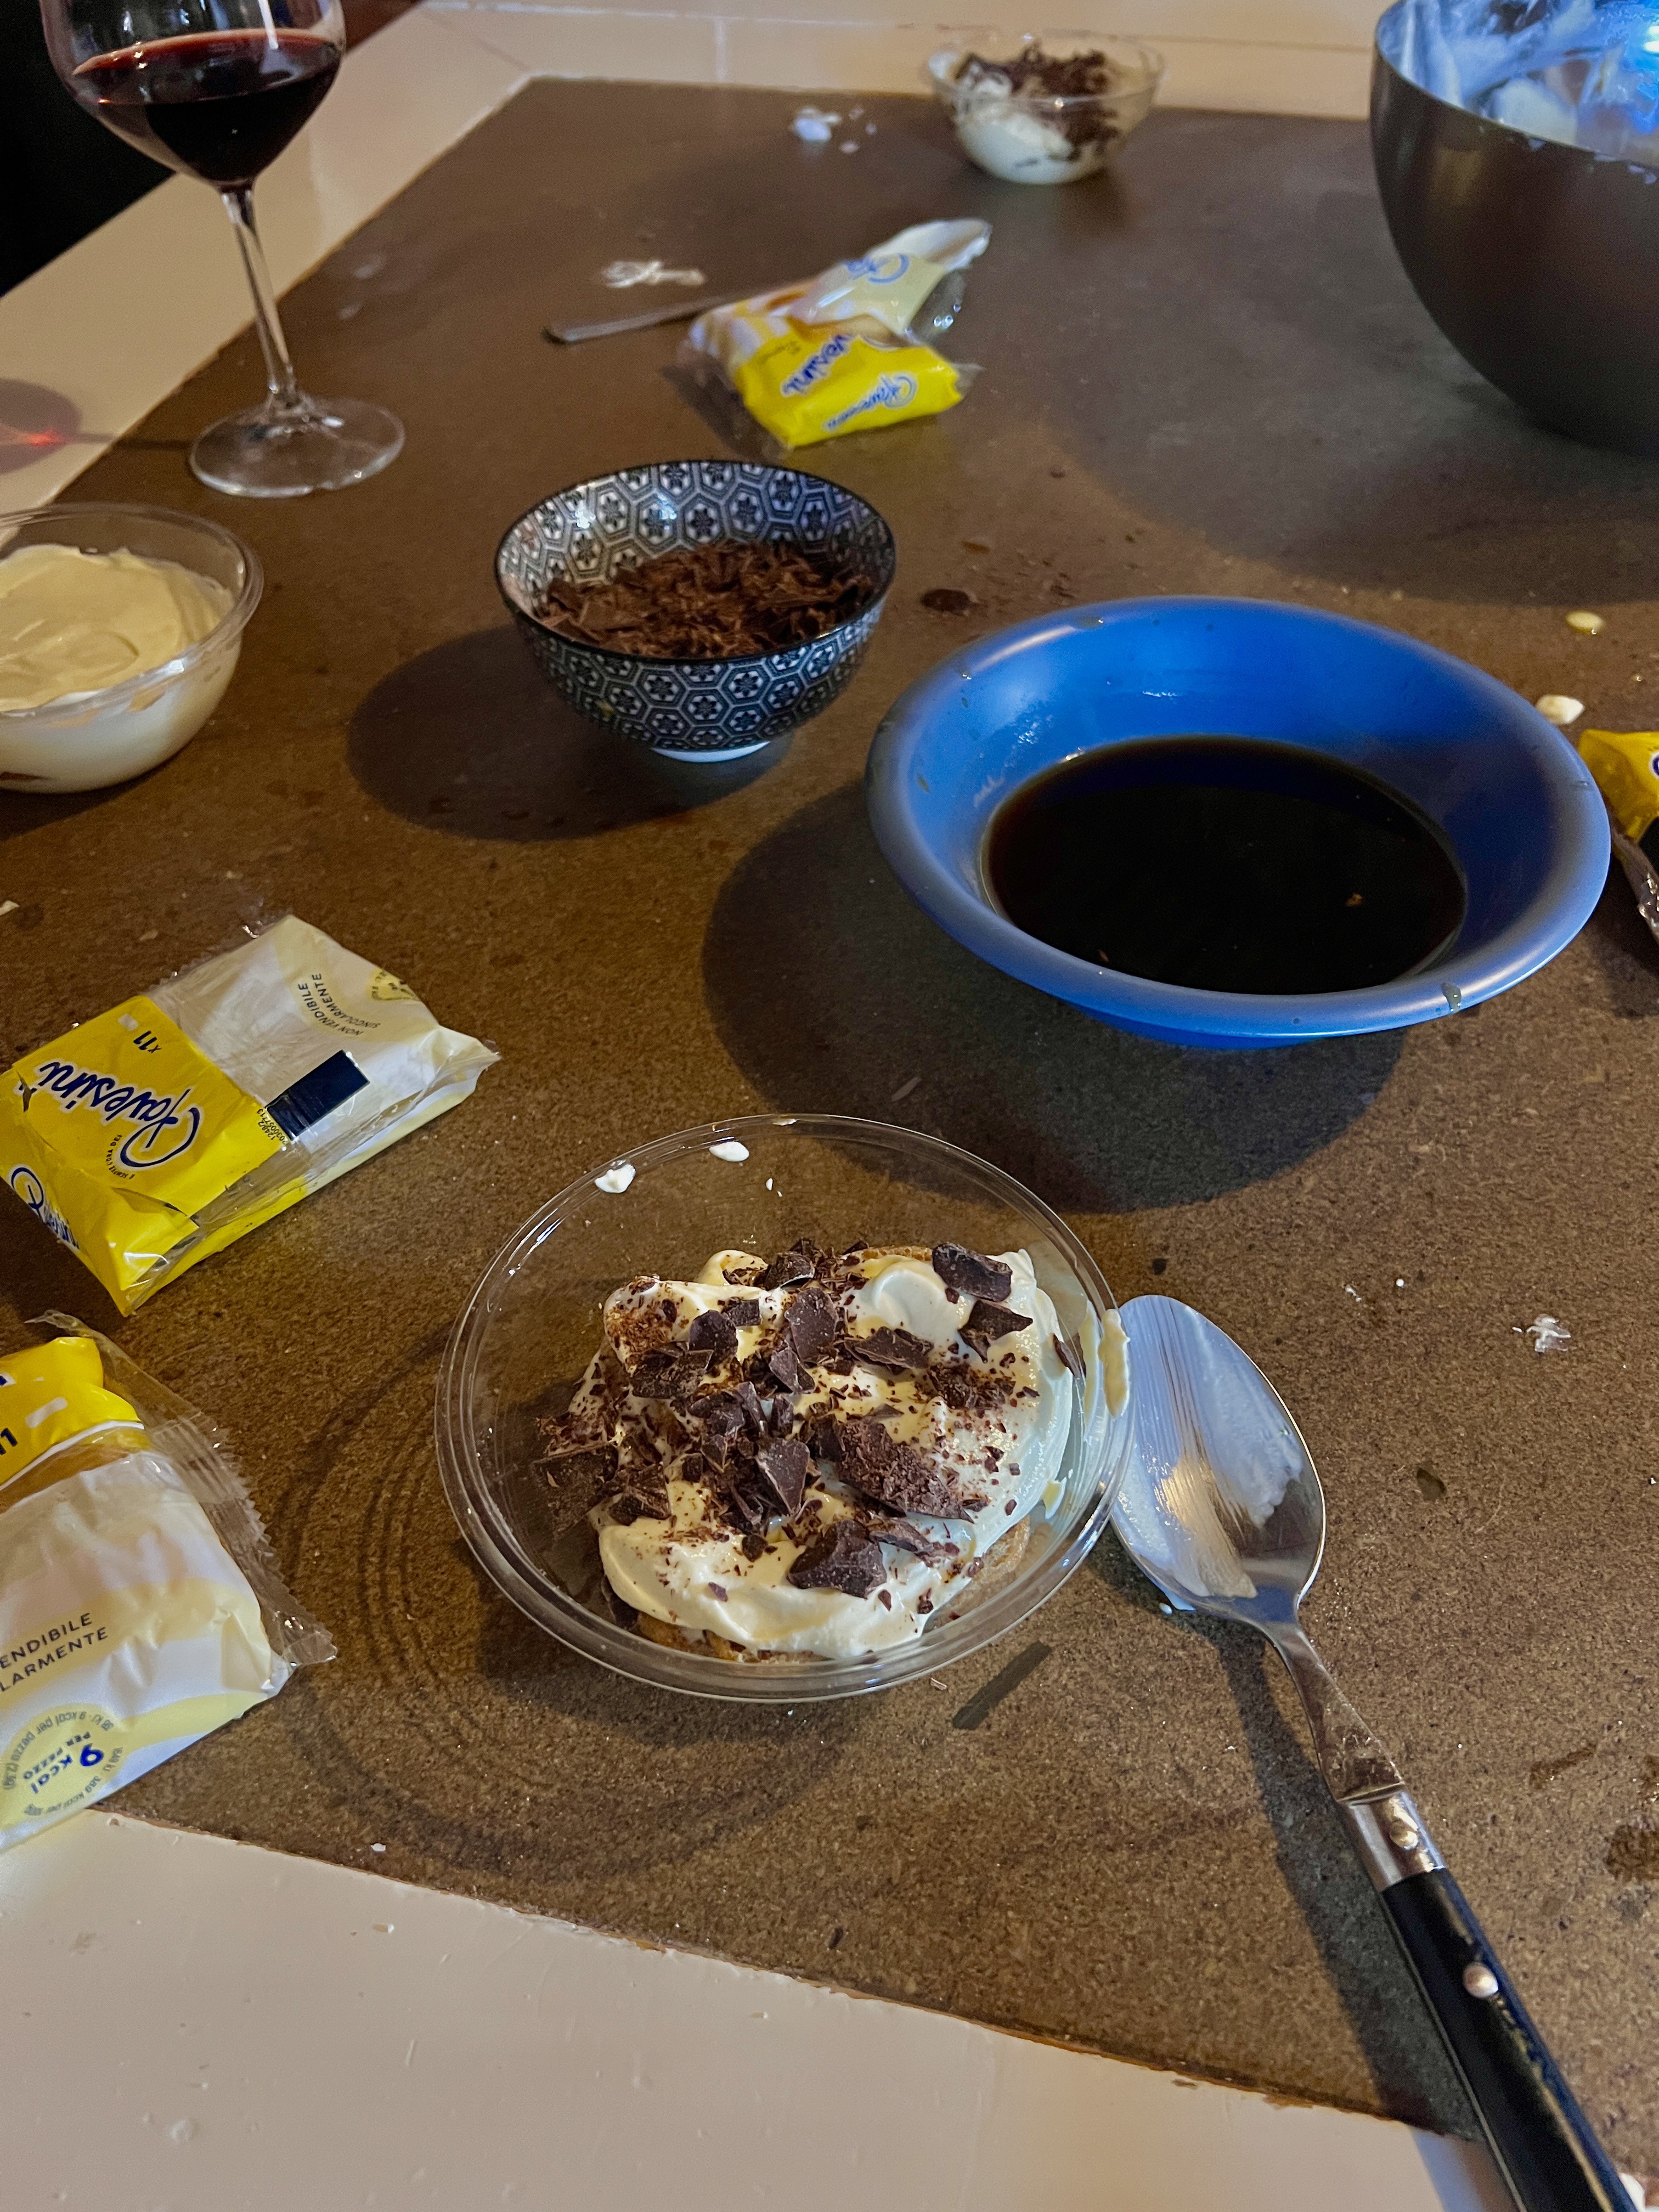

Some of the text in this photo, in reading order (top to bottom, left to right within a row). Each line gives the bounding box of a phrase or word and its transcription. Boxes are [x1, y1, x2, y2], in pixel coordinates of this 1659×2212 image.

[298, 983, 340, 1029] VENDIBILE
[312, 973, 381, 1029] SINGOLARMENTE
[133, 1030, 162, 1053] x11
[338, 1026, 364, 1036] NON
[18, 1062, 200, 1167] Pavesini
[80, 1743, 104, 1767] 9
